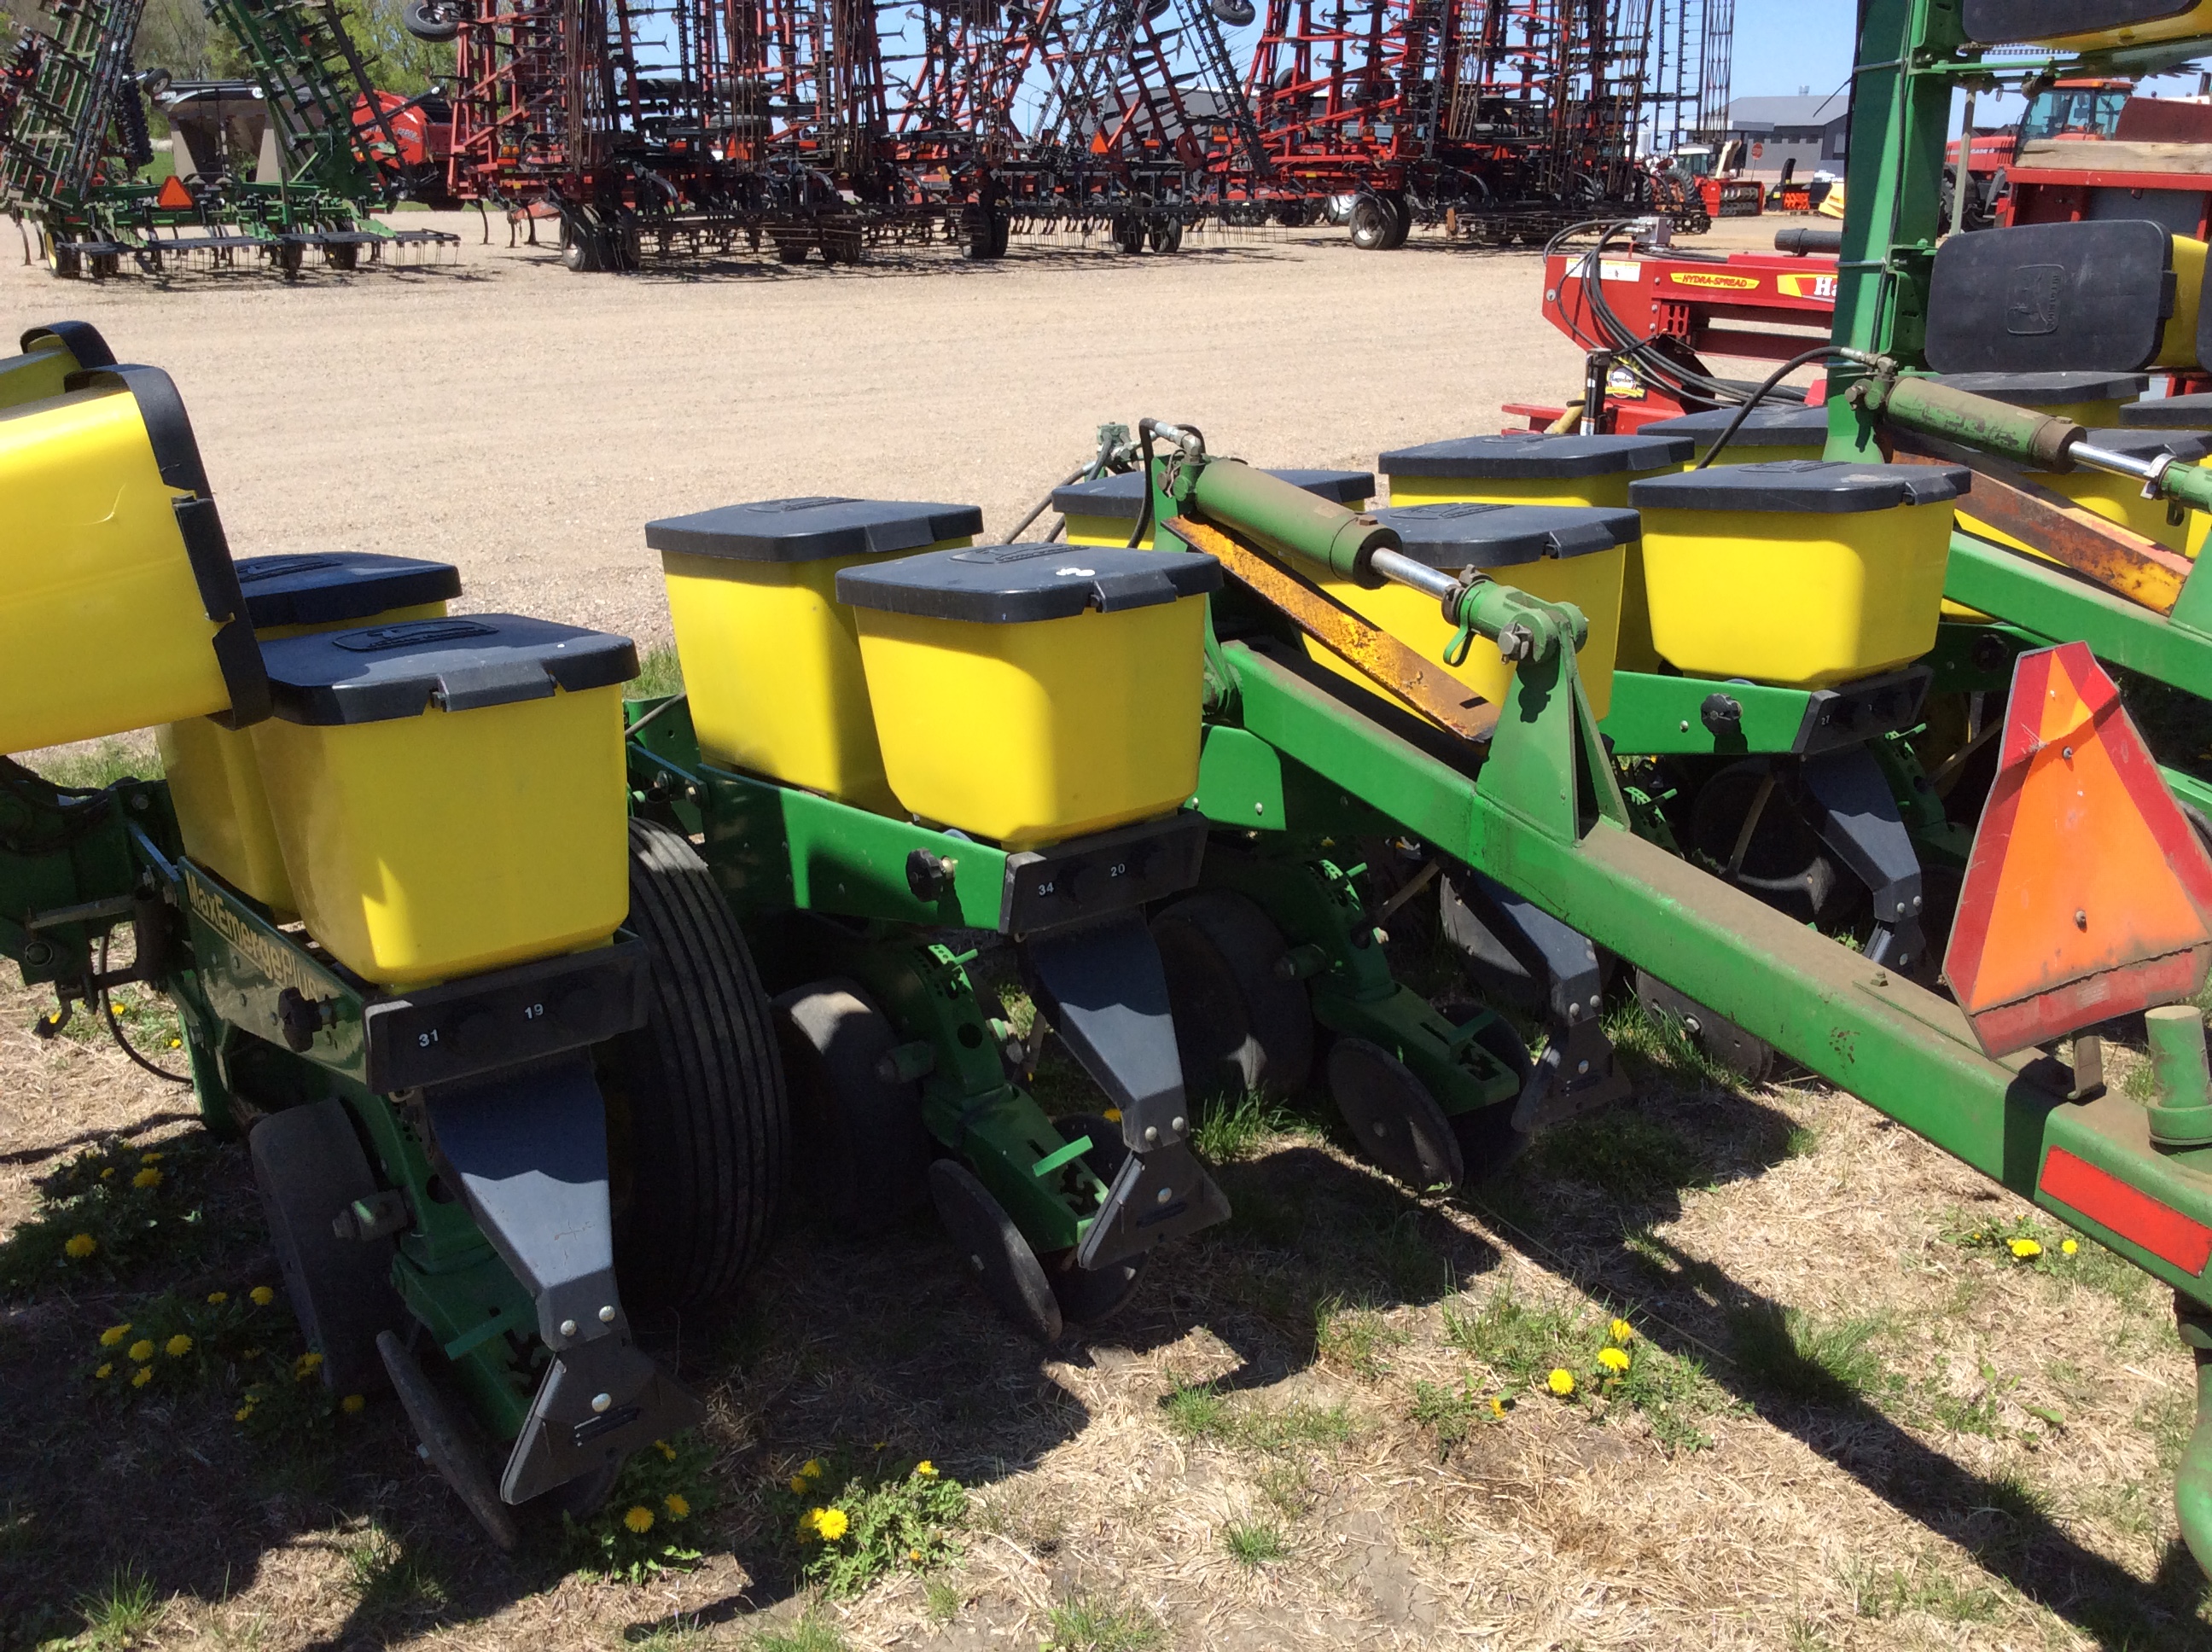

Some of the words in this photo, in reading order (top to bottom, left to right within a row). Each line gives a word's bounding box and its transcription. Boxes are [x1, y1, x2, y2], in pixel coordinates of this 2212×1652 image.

[1682, 274, 1748, 288] HYDRA-SPREAD
[1110, 864, 1125, 876] 20
[1039, 882, 1054, 895] 34
[525, 1003, 544, 1019] 19
[418, 1029, 439, 1047] 31
